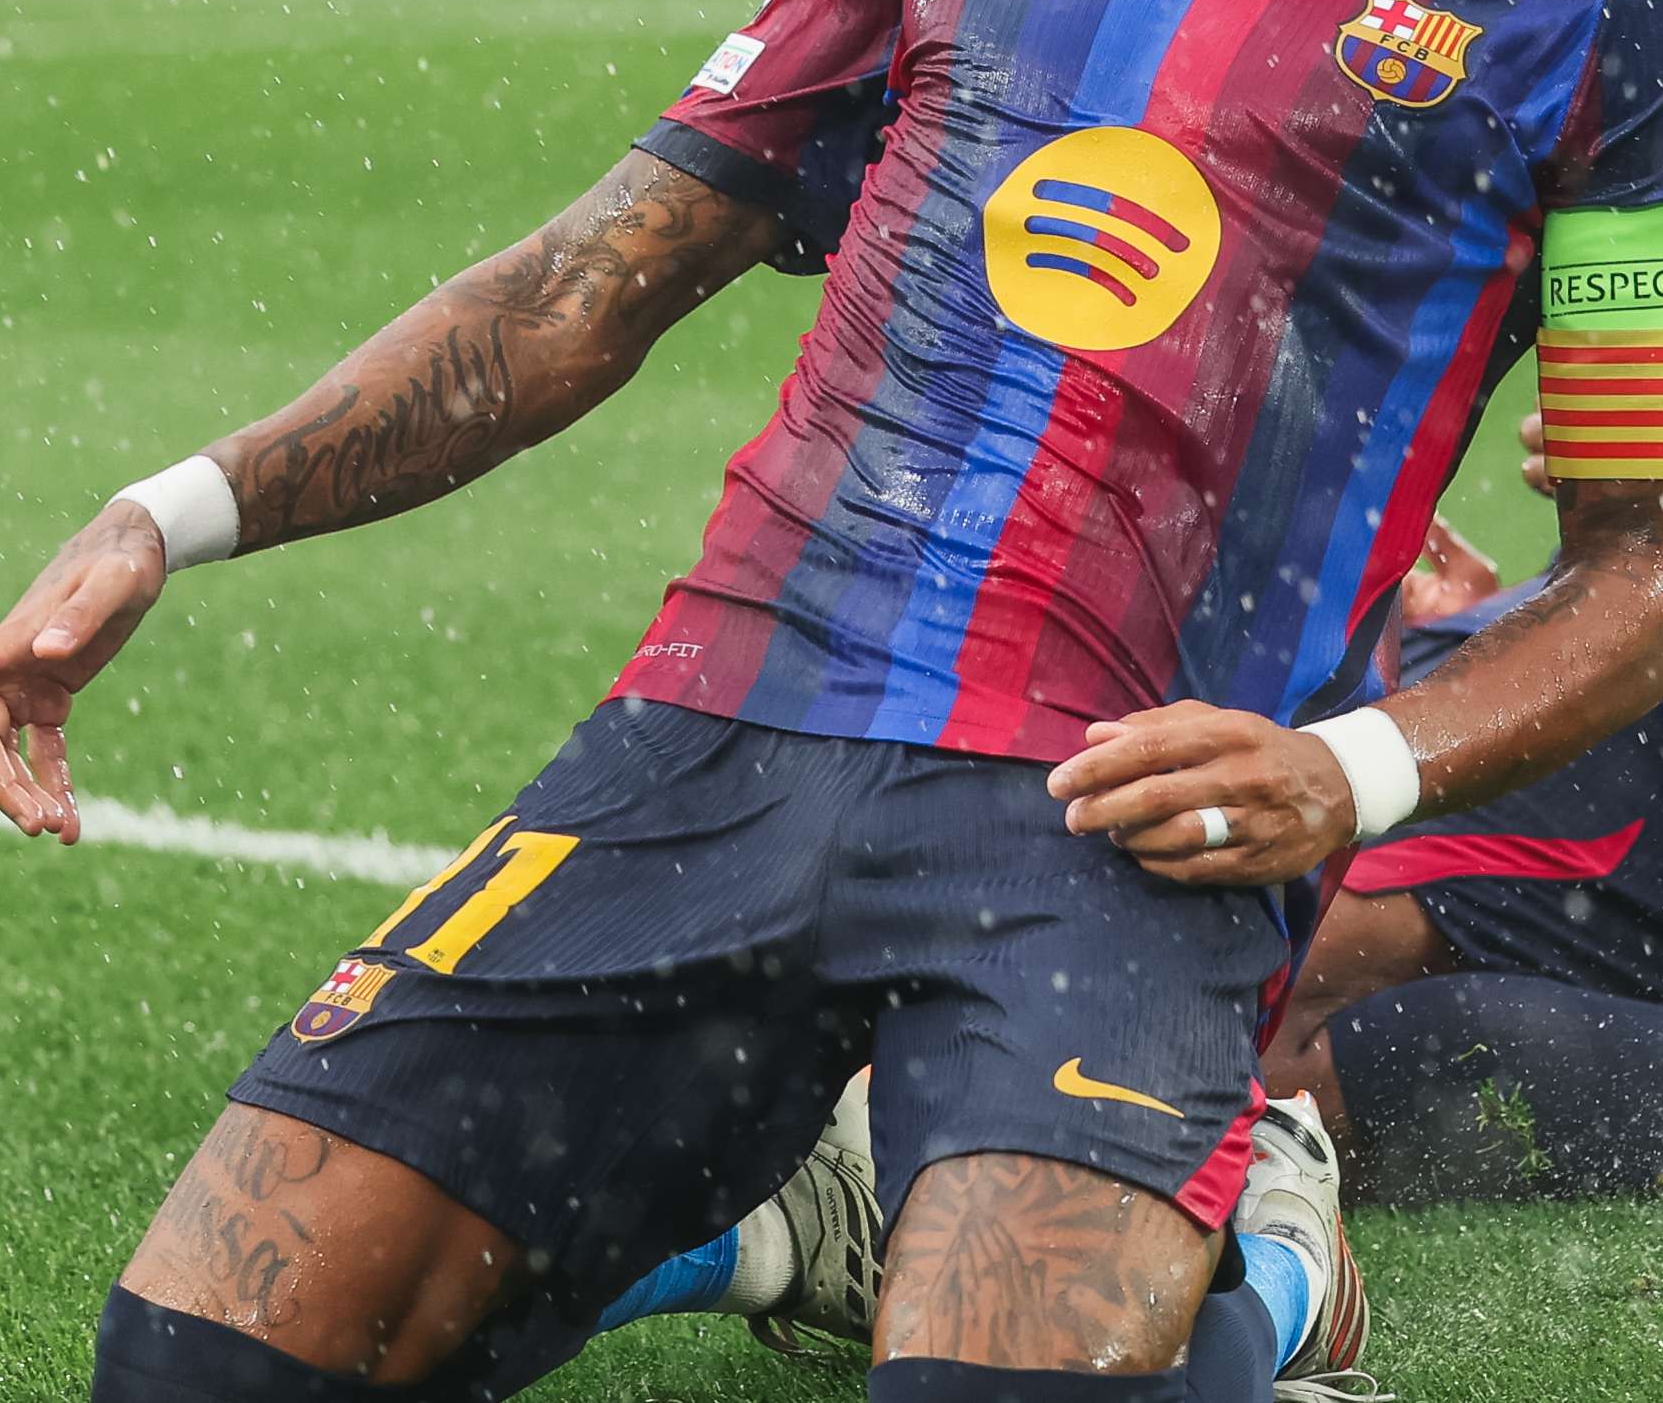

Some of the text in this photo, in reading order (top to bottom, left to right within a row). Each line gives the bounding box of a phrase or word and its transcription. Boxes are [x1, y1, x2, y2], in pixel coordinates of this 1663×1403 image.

[1379, 34, 1429, 60] FCB
[324, 993, 352, 1006] FCB
[825, 1187, 842, 1243] TRABALHO
